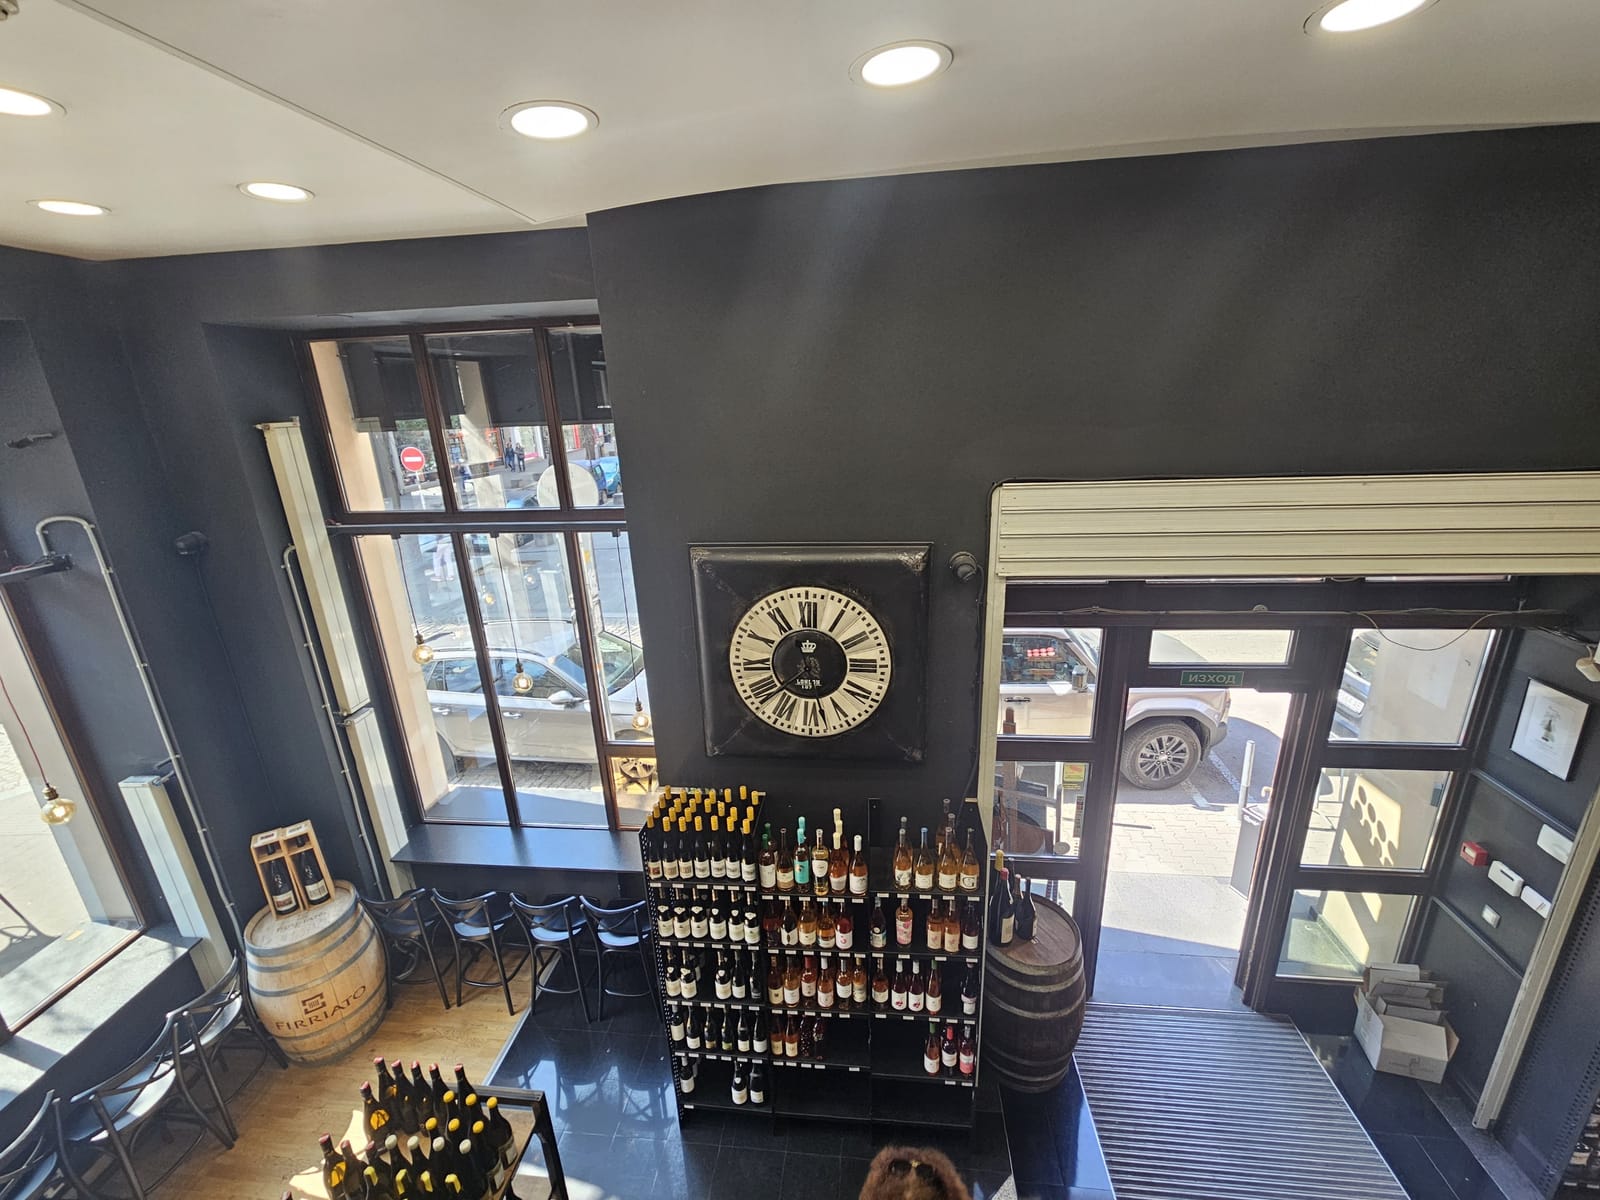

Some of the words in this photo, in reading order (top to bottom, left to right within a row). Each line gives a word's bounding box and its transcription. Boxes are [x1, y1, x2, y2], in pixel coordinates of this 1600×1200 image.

[767, 606, 793, 635] XI
[799, 601, 817, 628] XII
[829, 608, 845, 632] I
[747, 629, 775, 648] X
[841, 630, 870, 650] II
[743, 657, 770, 671] IX
[849, 658, 877, 673] III
[1188, 674, 1236, 684] ИЗХОД
[772, 691, 798, 721] VII
[803, 701, 819, 727] VI
[830, 696, 849, 721] V
[275, 985, 367, 1031] FIRRIATO
